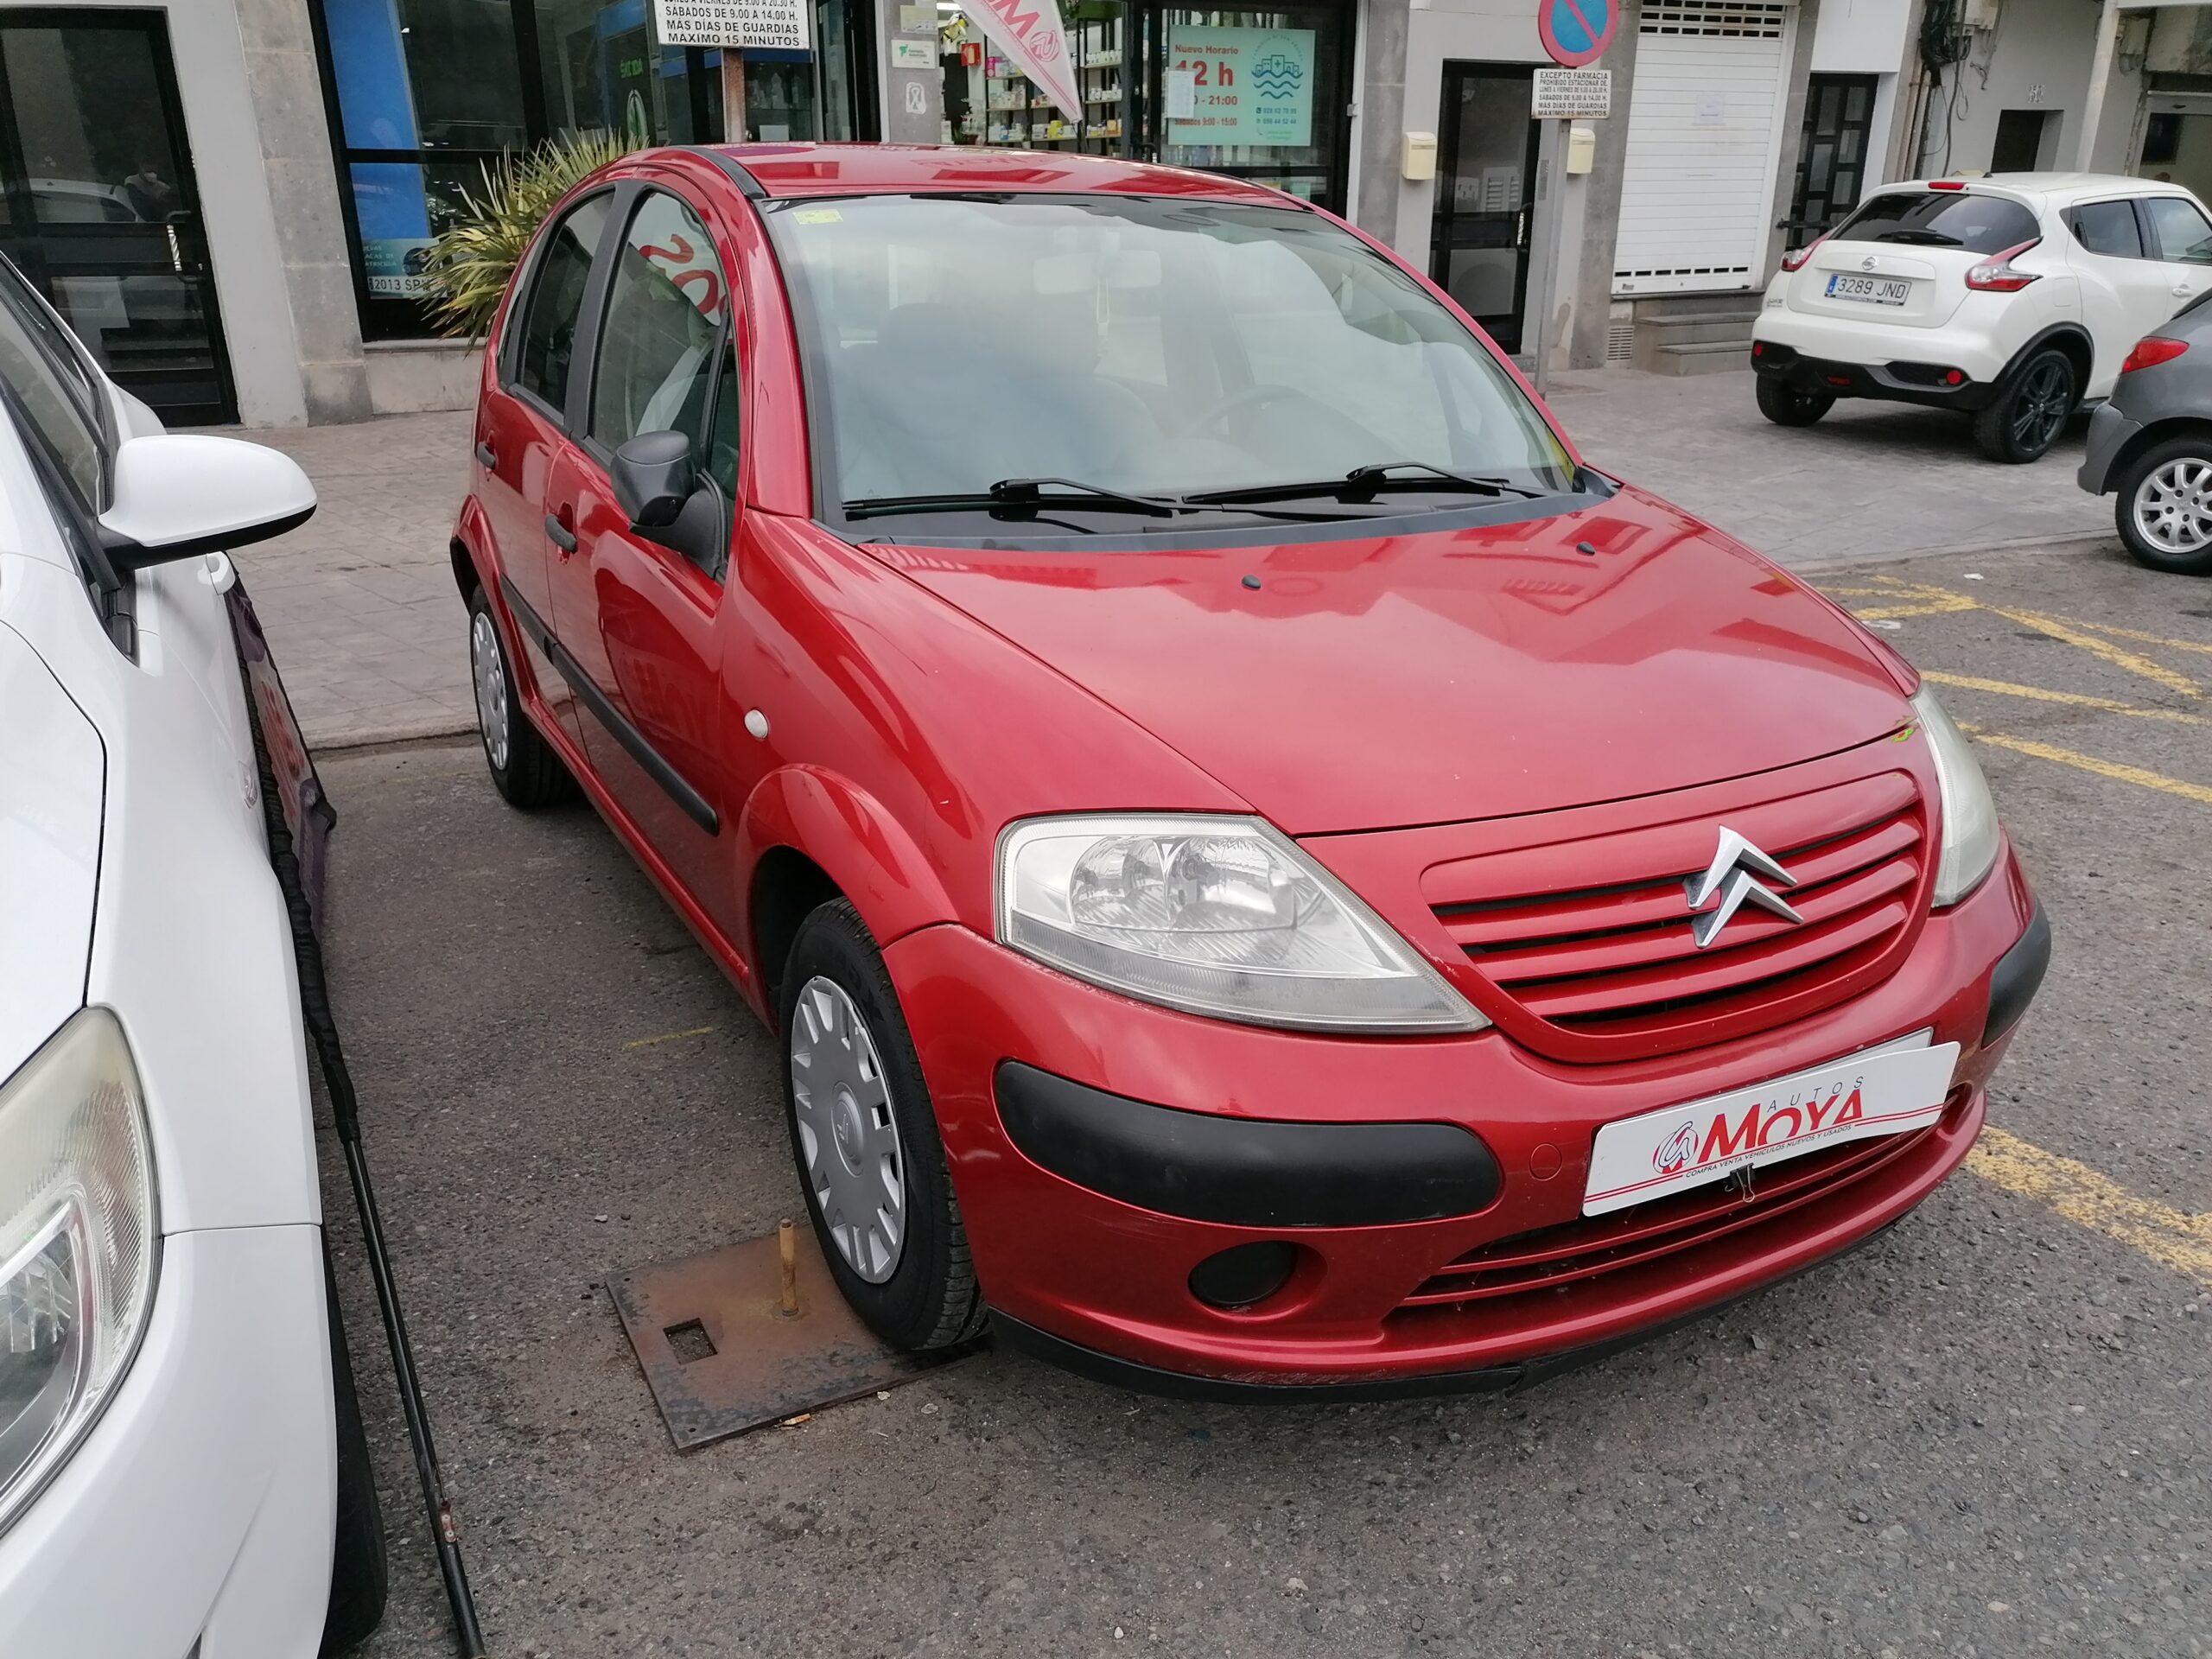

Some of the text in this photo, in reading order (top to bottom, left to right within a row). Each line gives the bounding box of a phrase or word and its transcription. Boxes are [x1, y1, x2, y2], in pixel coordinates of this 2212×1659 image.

[715, 8, 727, 18] DE
[729, 8, 750, 19] 9.00
[752, 10, 760, 19] A
[761, 10, 786, 21] 14.00
[788, 11, 798, 22] H.
[666, 17, 798, 35] MÁS DÍAS DE GUARDIAS
[725, 35, 740, 45] 15
[743, 35, 800, 47] MINUTOS
[1175, 44, 1239, 55] Nuevo Horario
[1540, 71, 1609, 80] EXCEPTO FARMACIA
[1208, 95, 1238, 105] 21:00
[374, 278, 401, 290] 2013
[1837, 277, 1907, 299] 3289 JND
[1767, 1076, 1864, 1113] AUTOS
[1697, 1088, 1864, 1164] MOYA
[1686, 1165, 1718, 1178] COMPRA
[1719, 1156, 1743, 1167] VENTA
[1745, 1142, 1786, 1160] VEHICULOS
[1786, 1134, 1815, 1148] NUEVOS
[1823, 1124, 1853, 1138] USADOS
